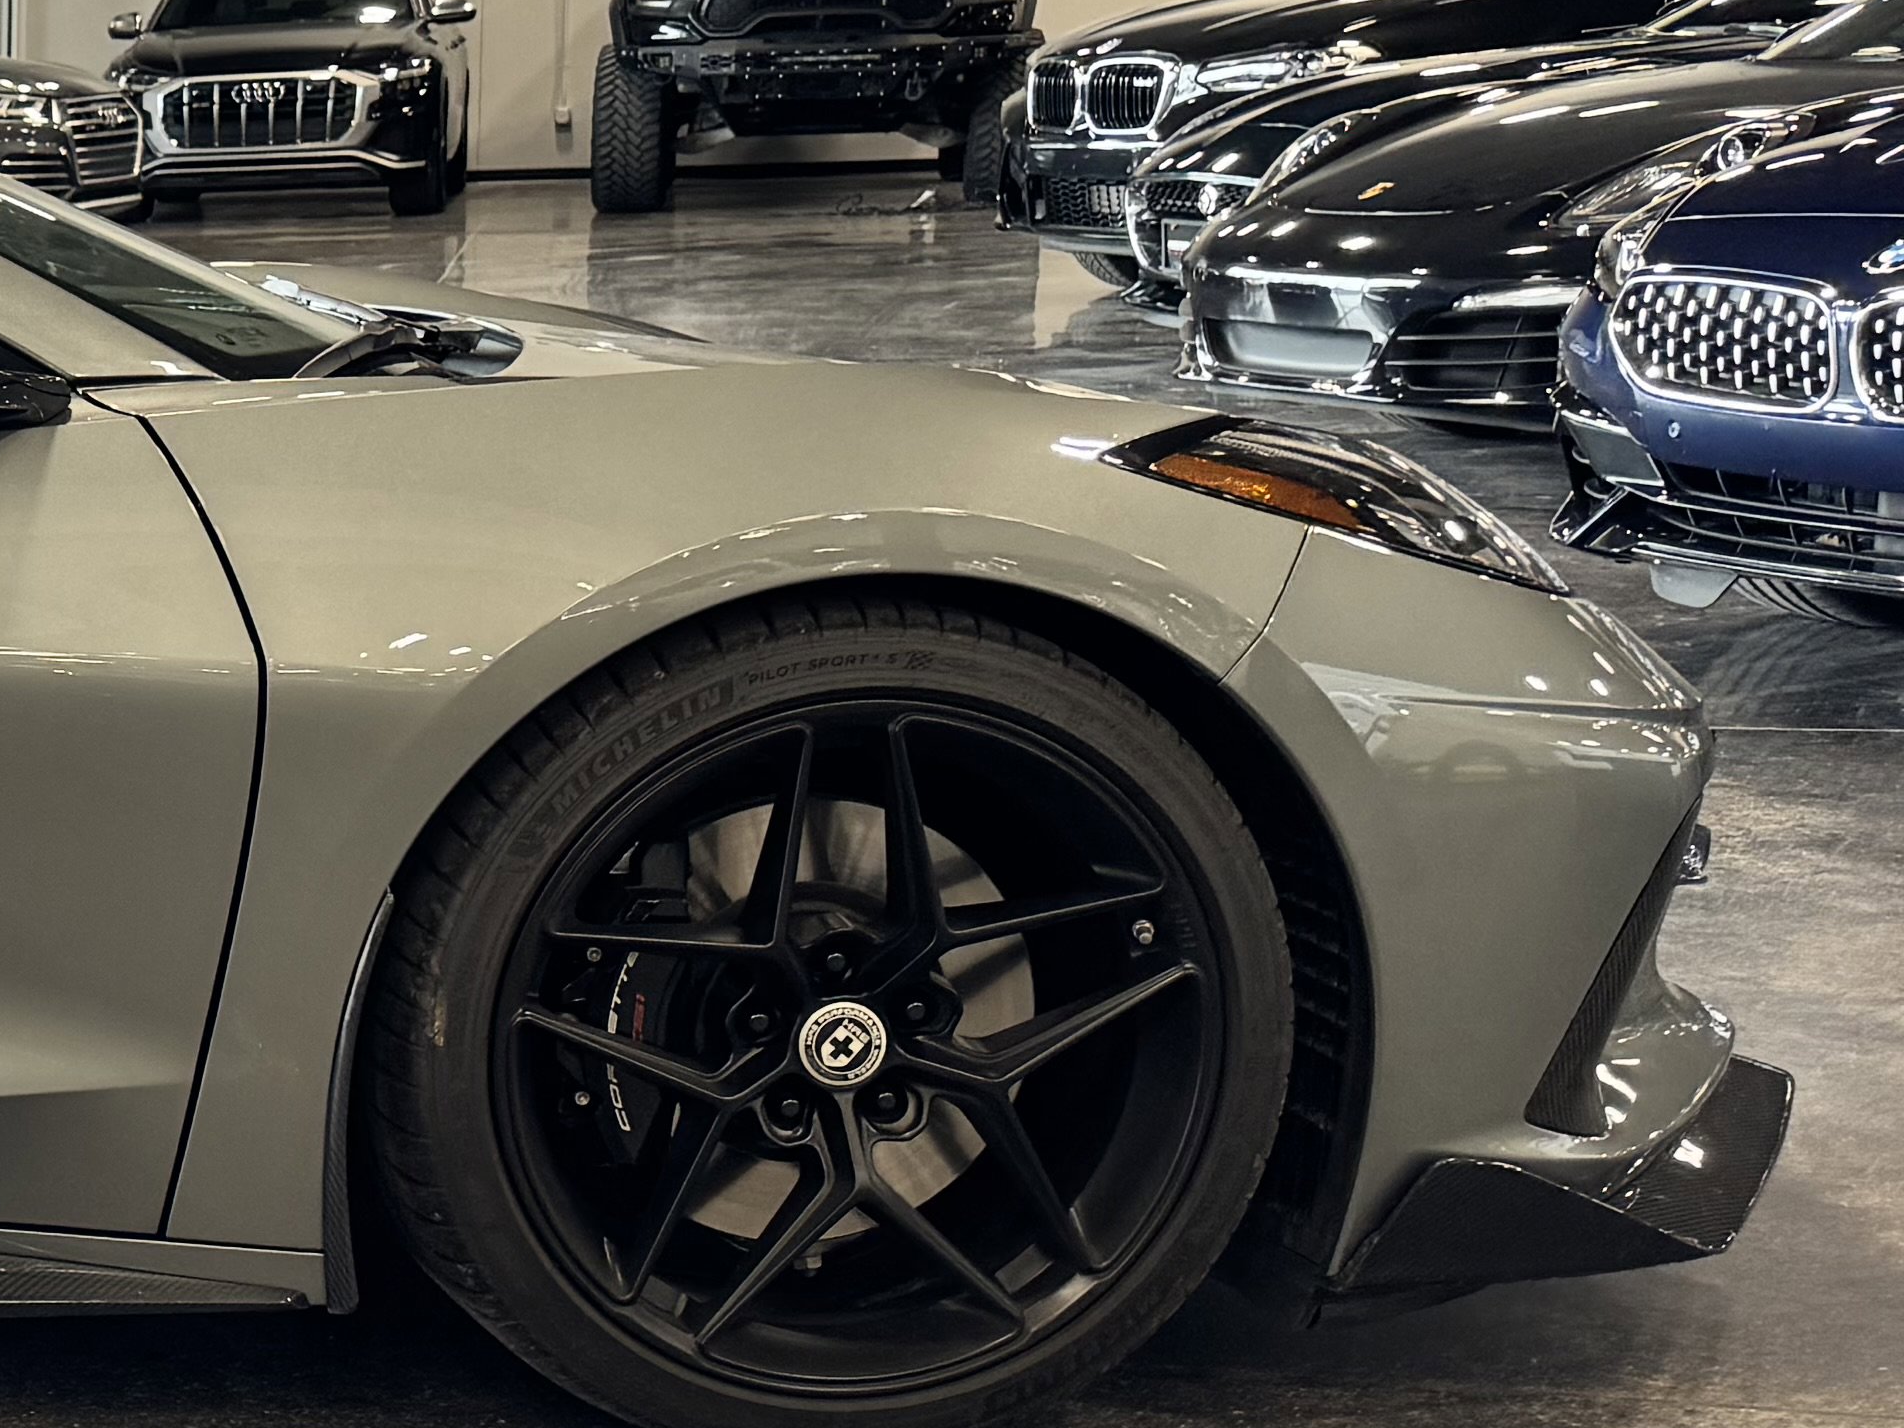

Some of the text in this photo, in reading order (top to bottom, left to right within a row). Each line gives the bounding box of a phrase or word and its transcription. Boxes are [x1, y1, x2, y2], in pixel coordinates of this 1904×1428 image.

[550, 683, 723, 814] MICHELIN
[747, 661, 802, 685] PILOT
[807, 652, 870, 671] SPORT
[604, 950, 640, 1133] CORETTE
